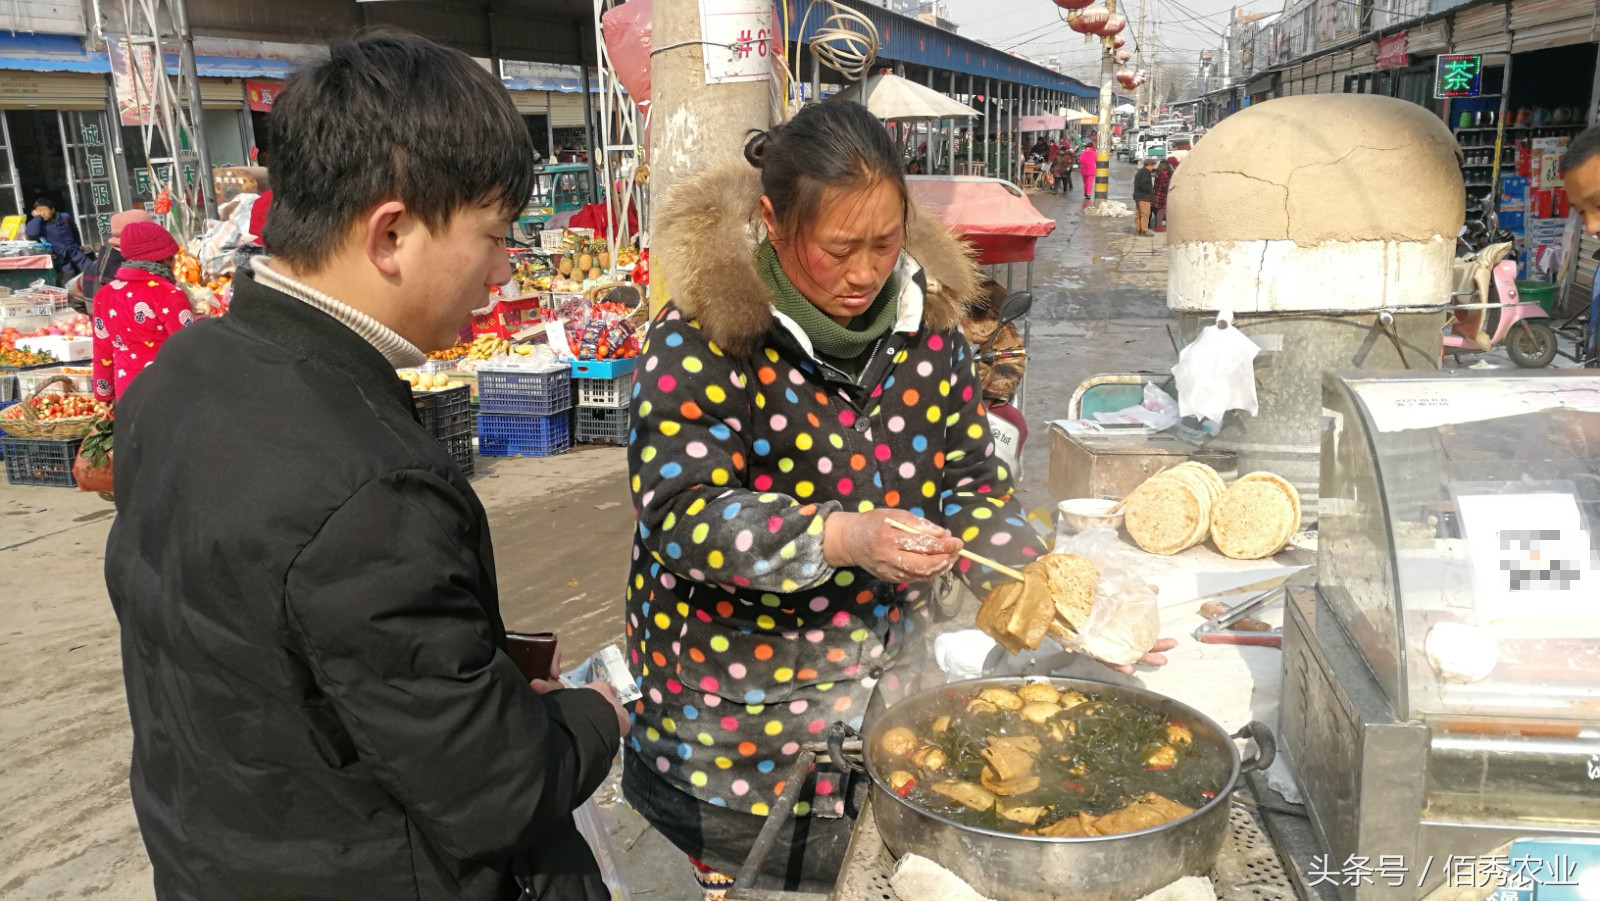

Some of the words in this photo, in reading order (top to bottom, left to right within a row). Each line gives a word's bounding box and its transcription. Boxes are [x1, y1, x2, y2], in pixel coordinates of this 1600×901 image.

[1444, 60, 1475, 90] 茶
[81, 124, 111, 234] 诚信服务
